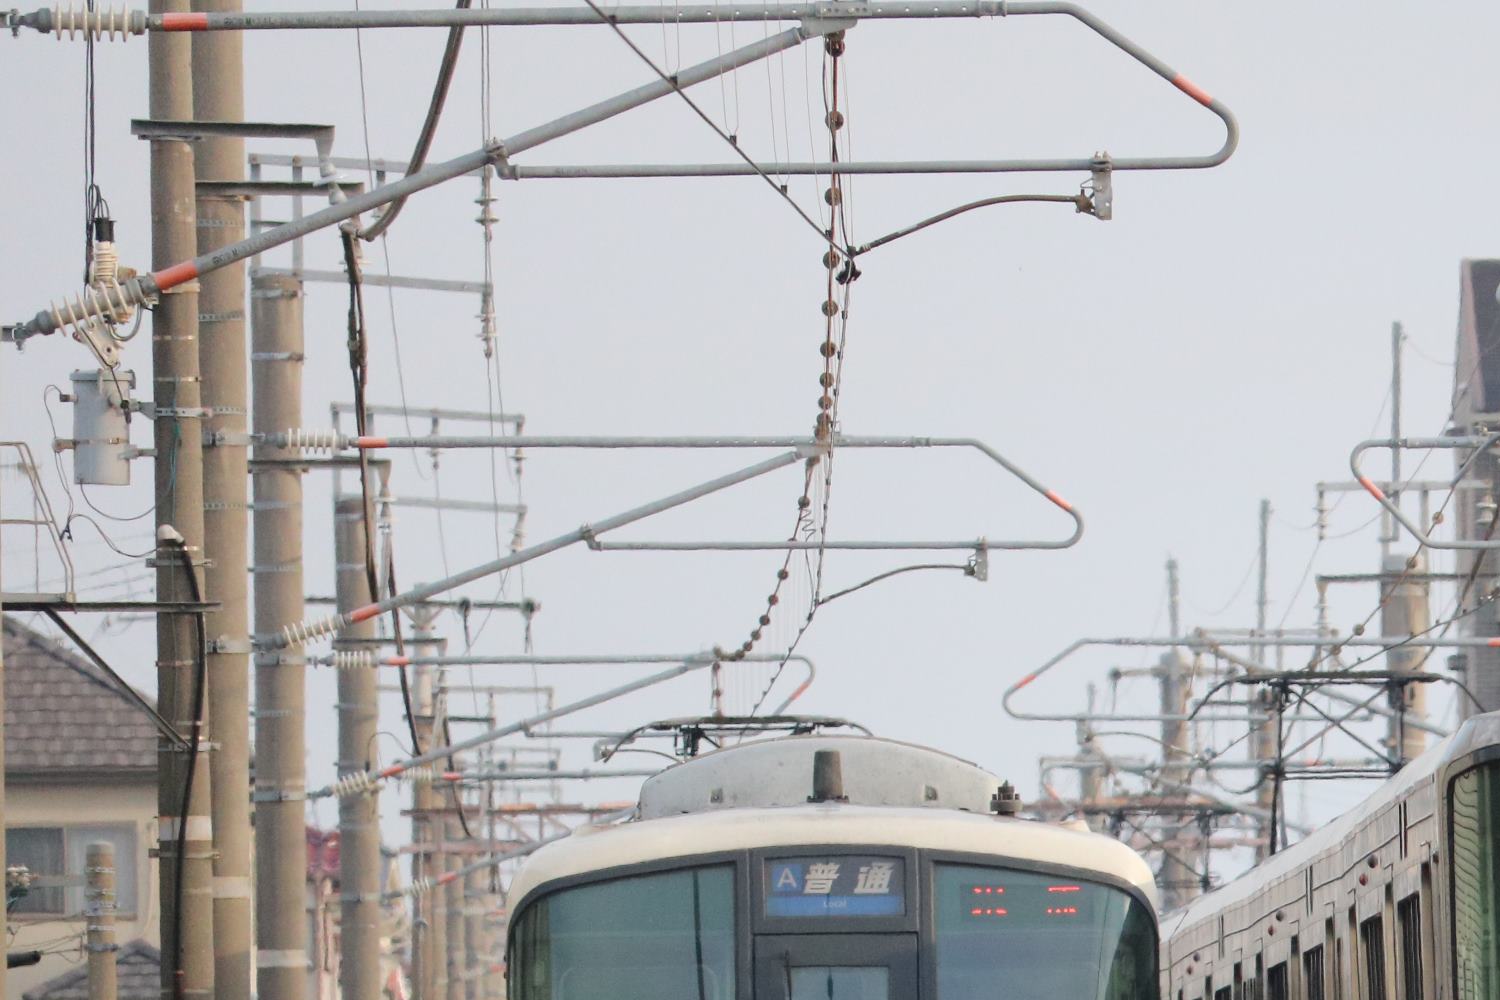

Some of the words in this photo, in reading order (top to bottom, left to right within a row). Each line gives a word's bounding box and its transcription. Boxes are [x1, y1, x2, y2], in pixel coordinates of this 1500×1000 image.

[777, 867, 798, 889] A
[803, 862, 896, 894] 普通
[823, 899, 848, 908] Local
